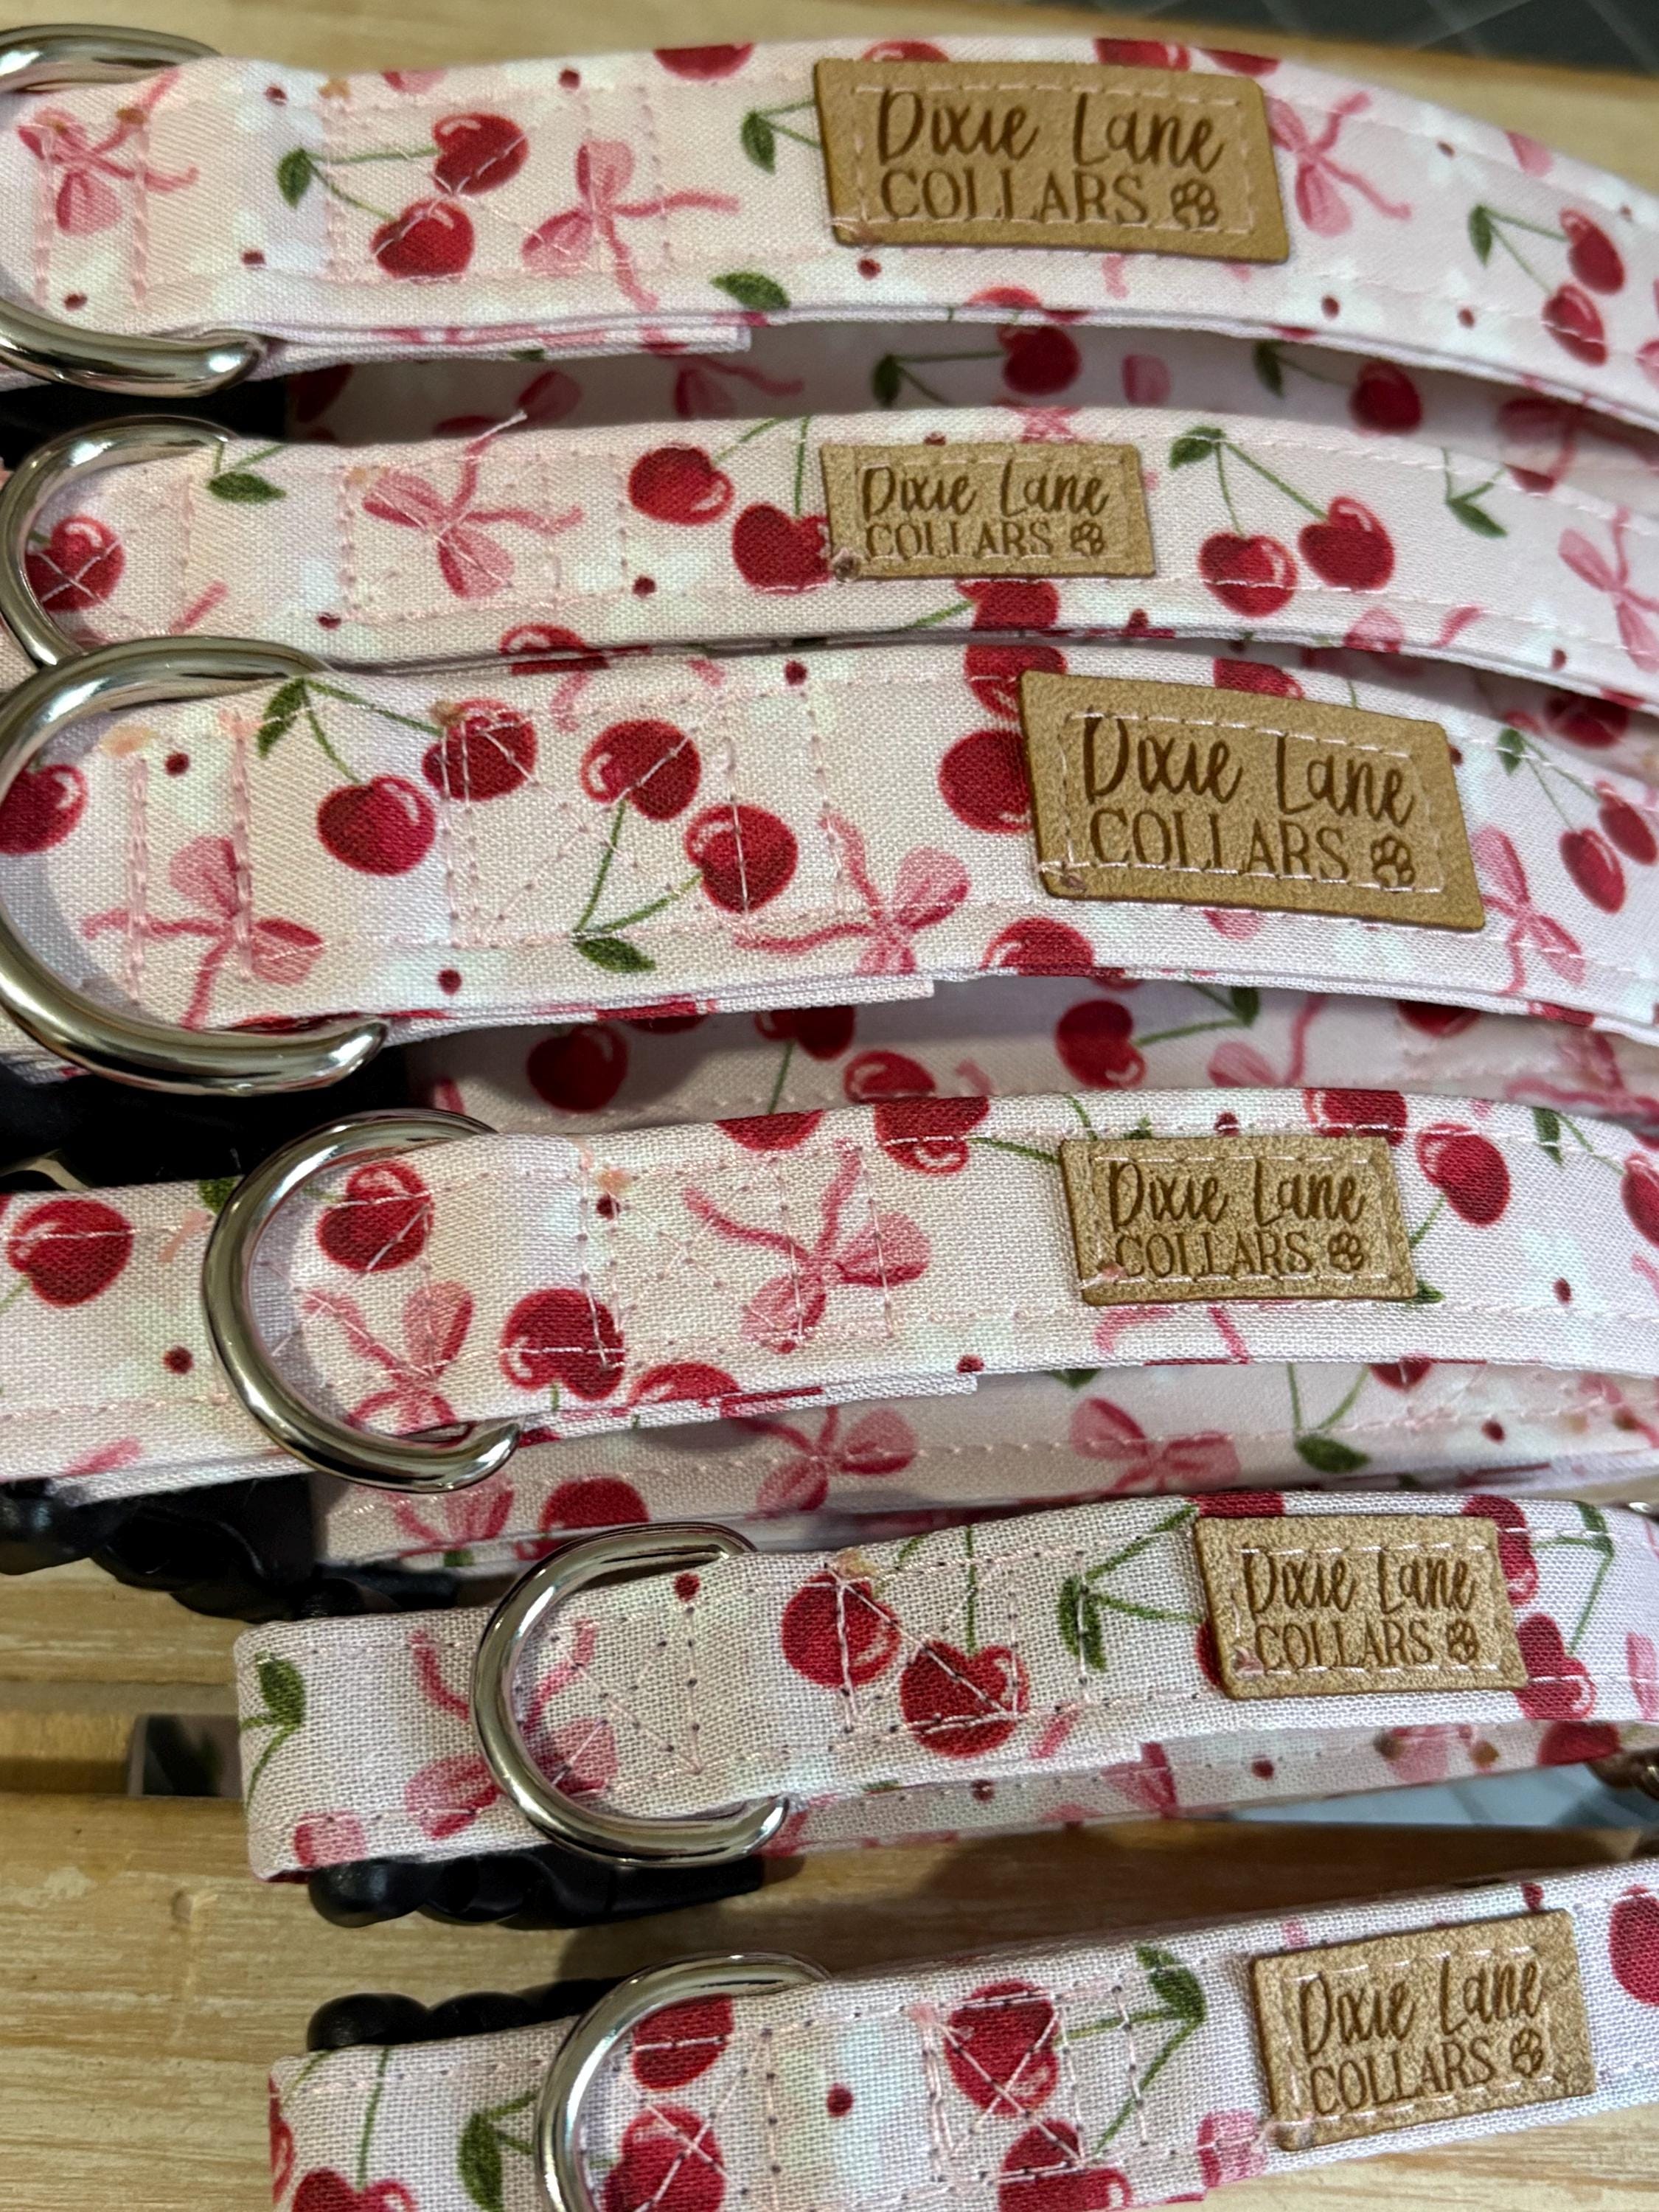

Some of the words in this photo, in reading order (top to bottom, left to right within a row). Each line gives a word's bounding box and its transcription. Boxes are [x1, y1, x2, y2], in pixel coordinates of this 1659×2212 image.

[877, 88, 1040, 167] Dixie
[1073, 92, 1225, 173] Lane
[882, 167, 1149, 223] COLLARS
[863, 466, 977, 521] Dixie
[1000, 459, 1109, 517] Lane
[865, 519, 1053, 560] COLLARS
[1083, 709, 1243, 804] Dixie
[1276, 734, 1414, 827] Lane
[1089, 808, 1349, 880] COLLARS
[1109, 1162, 1228, 1231] Dixie
[1253, 1159, 1366, 1226] Lane
[1115, 1230, 1312, 1278] COLLARS
[1242, 1547, 1356, 1621] Dixie
[1378, 1548, 1475, 1614] Lane
[1256, 1621, 1433, 1670] COLLARS
[1300, 1972, 1415, 2062] Dixie
[1439, 1955, 1543, 2036] Lane
[1310, 2036, 1495, 2115] COLLARS
